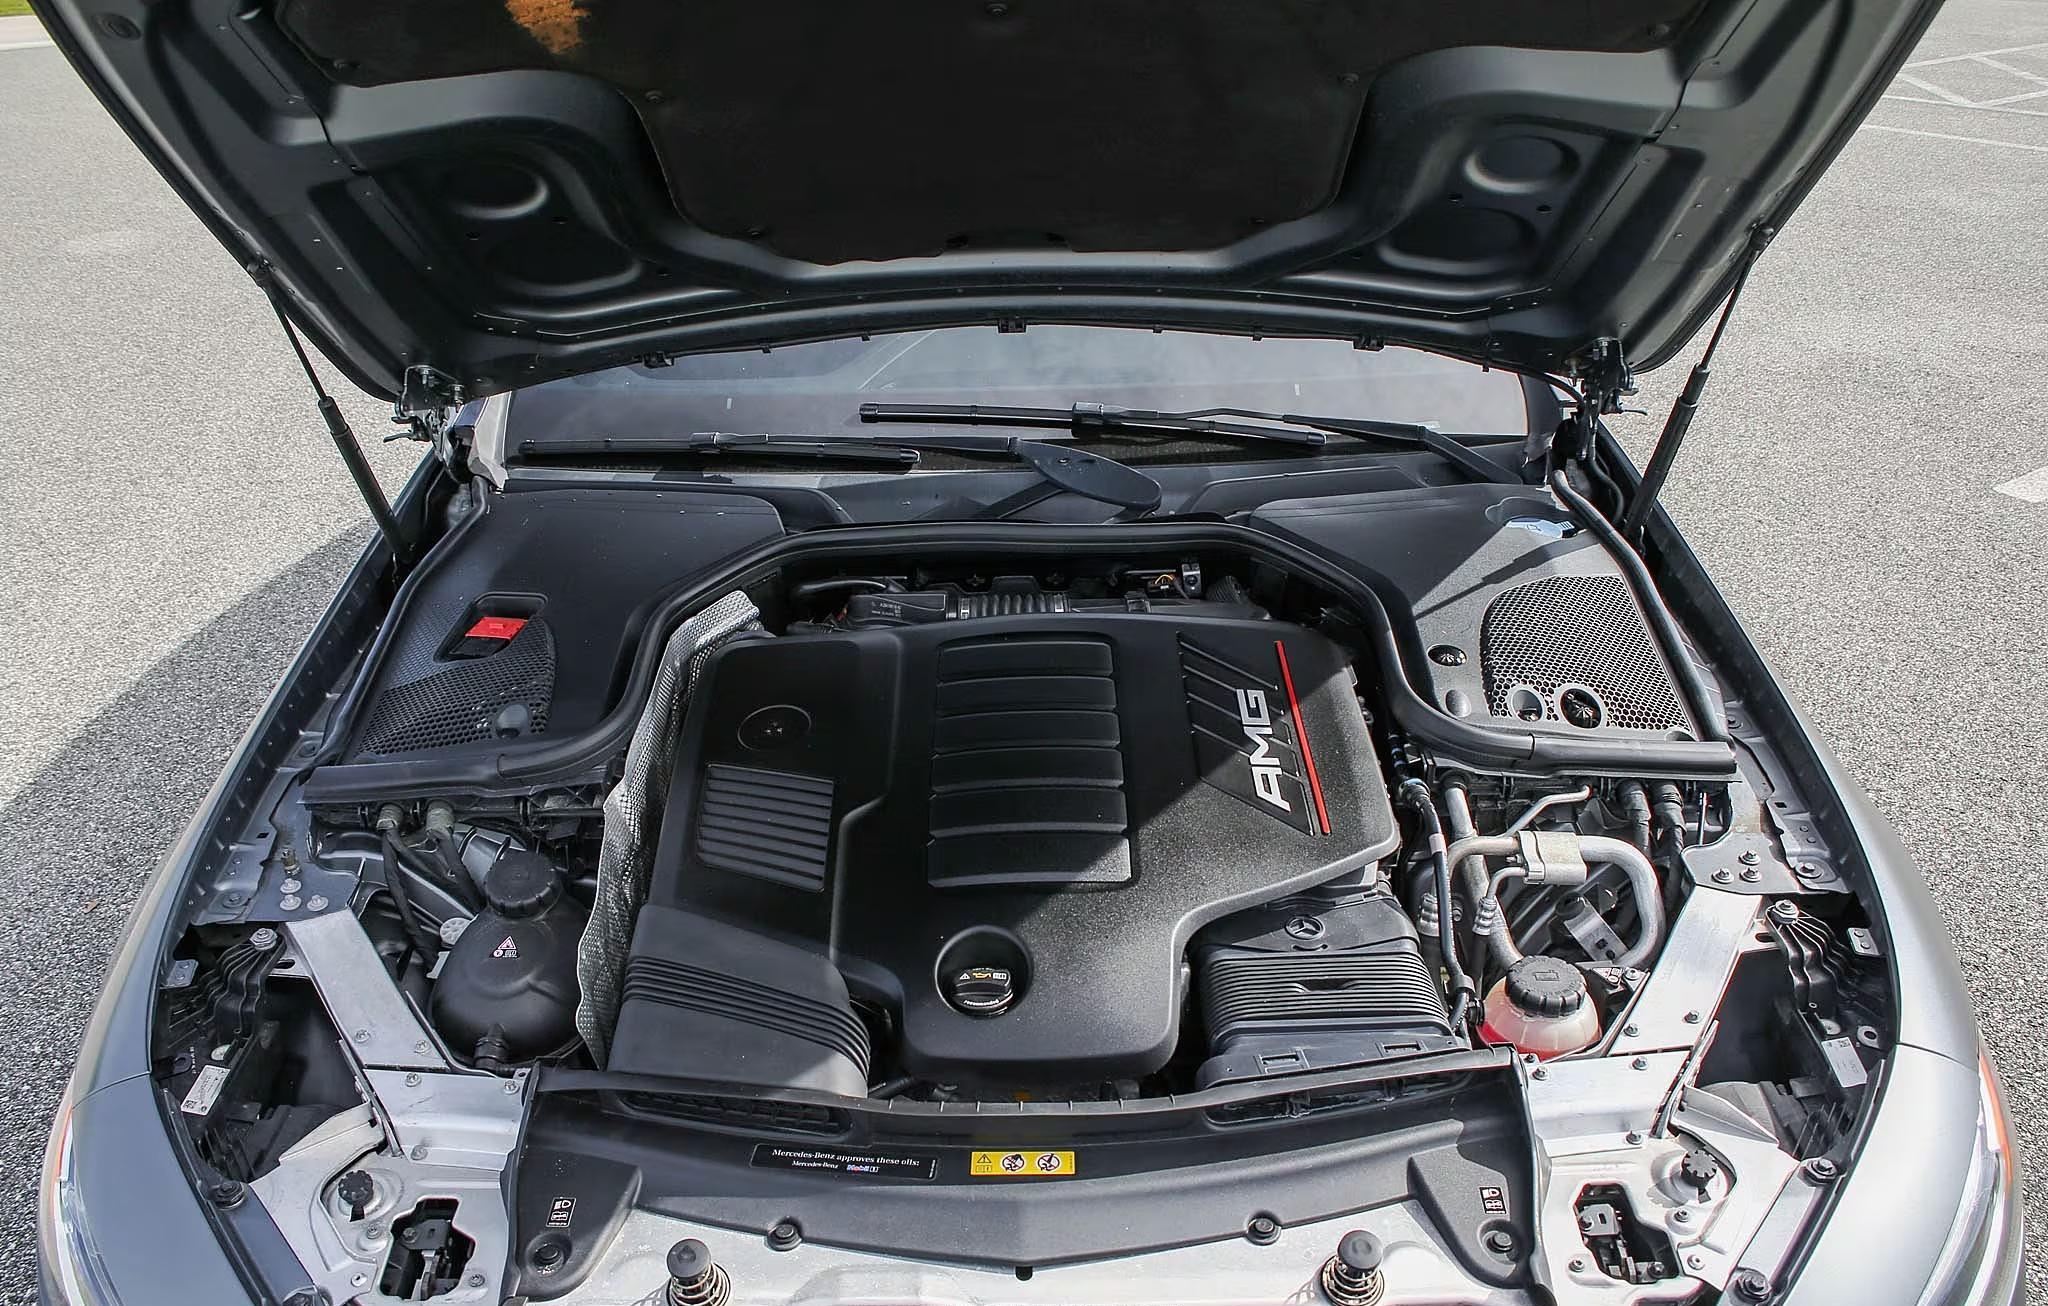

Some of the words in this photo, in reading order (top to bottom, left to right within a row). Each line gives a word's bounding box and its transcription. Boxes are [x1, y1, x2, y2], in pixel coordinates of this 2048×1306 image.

[1236, 688, 1291, 812] AMG
[772, 1149, 836, 1160] Mercedes-Benz
[836, 1154, 875, 1164] approves
[876, 1156, 900, 1165] these
[901, 1158, 920, 1166] oils:
